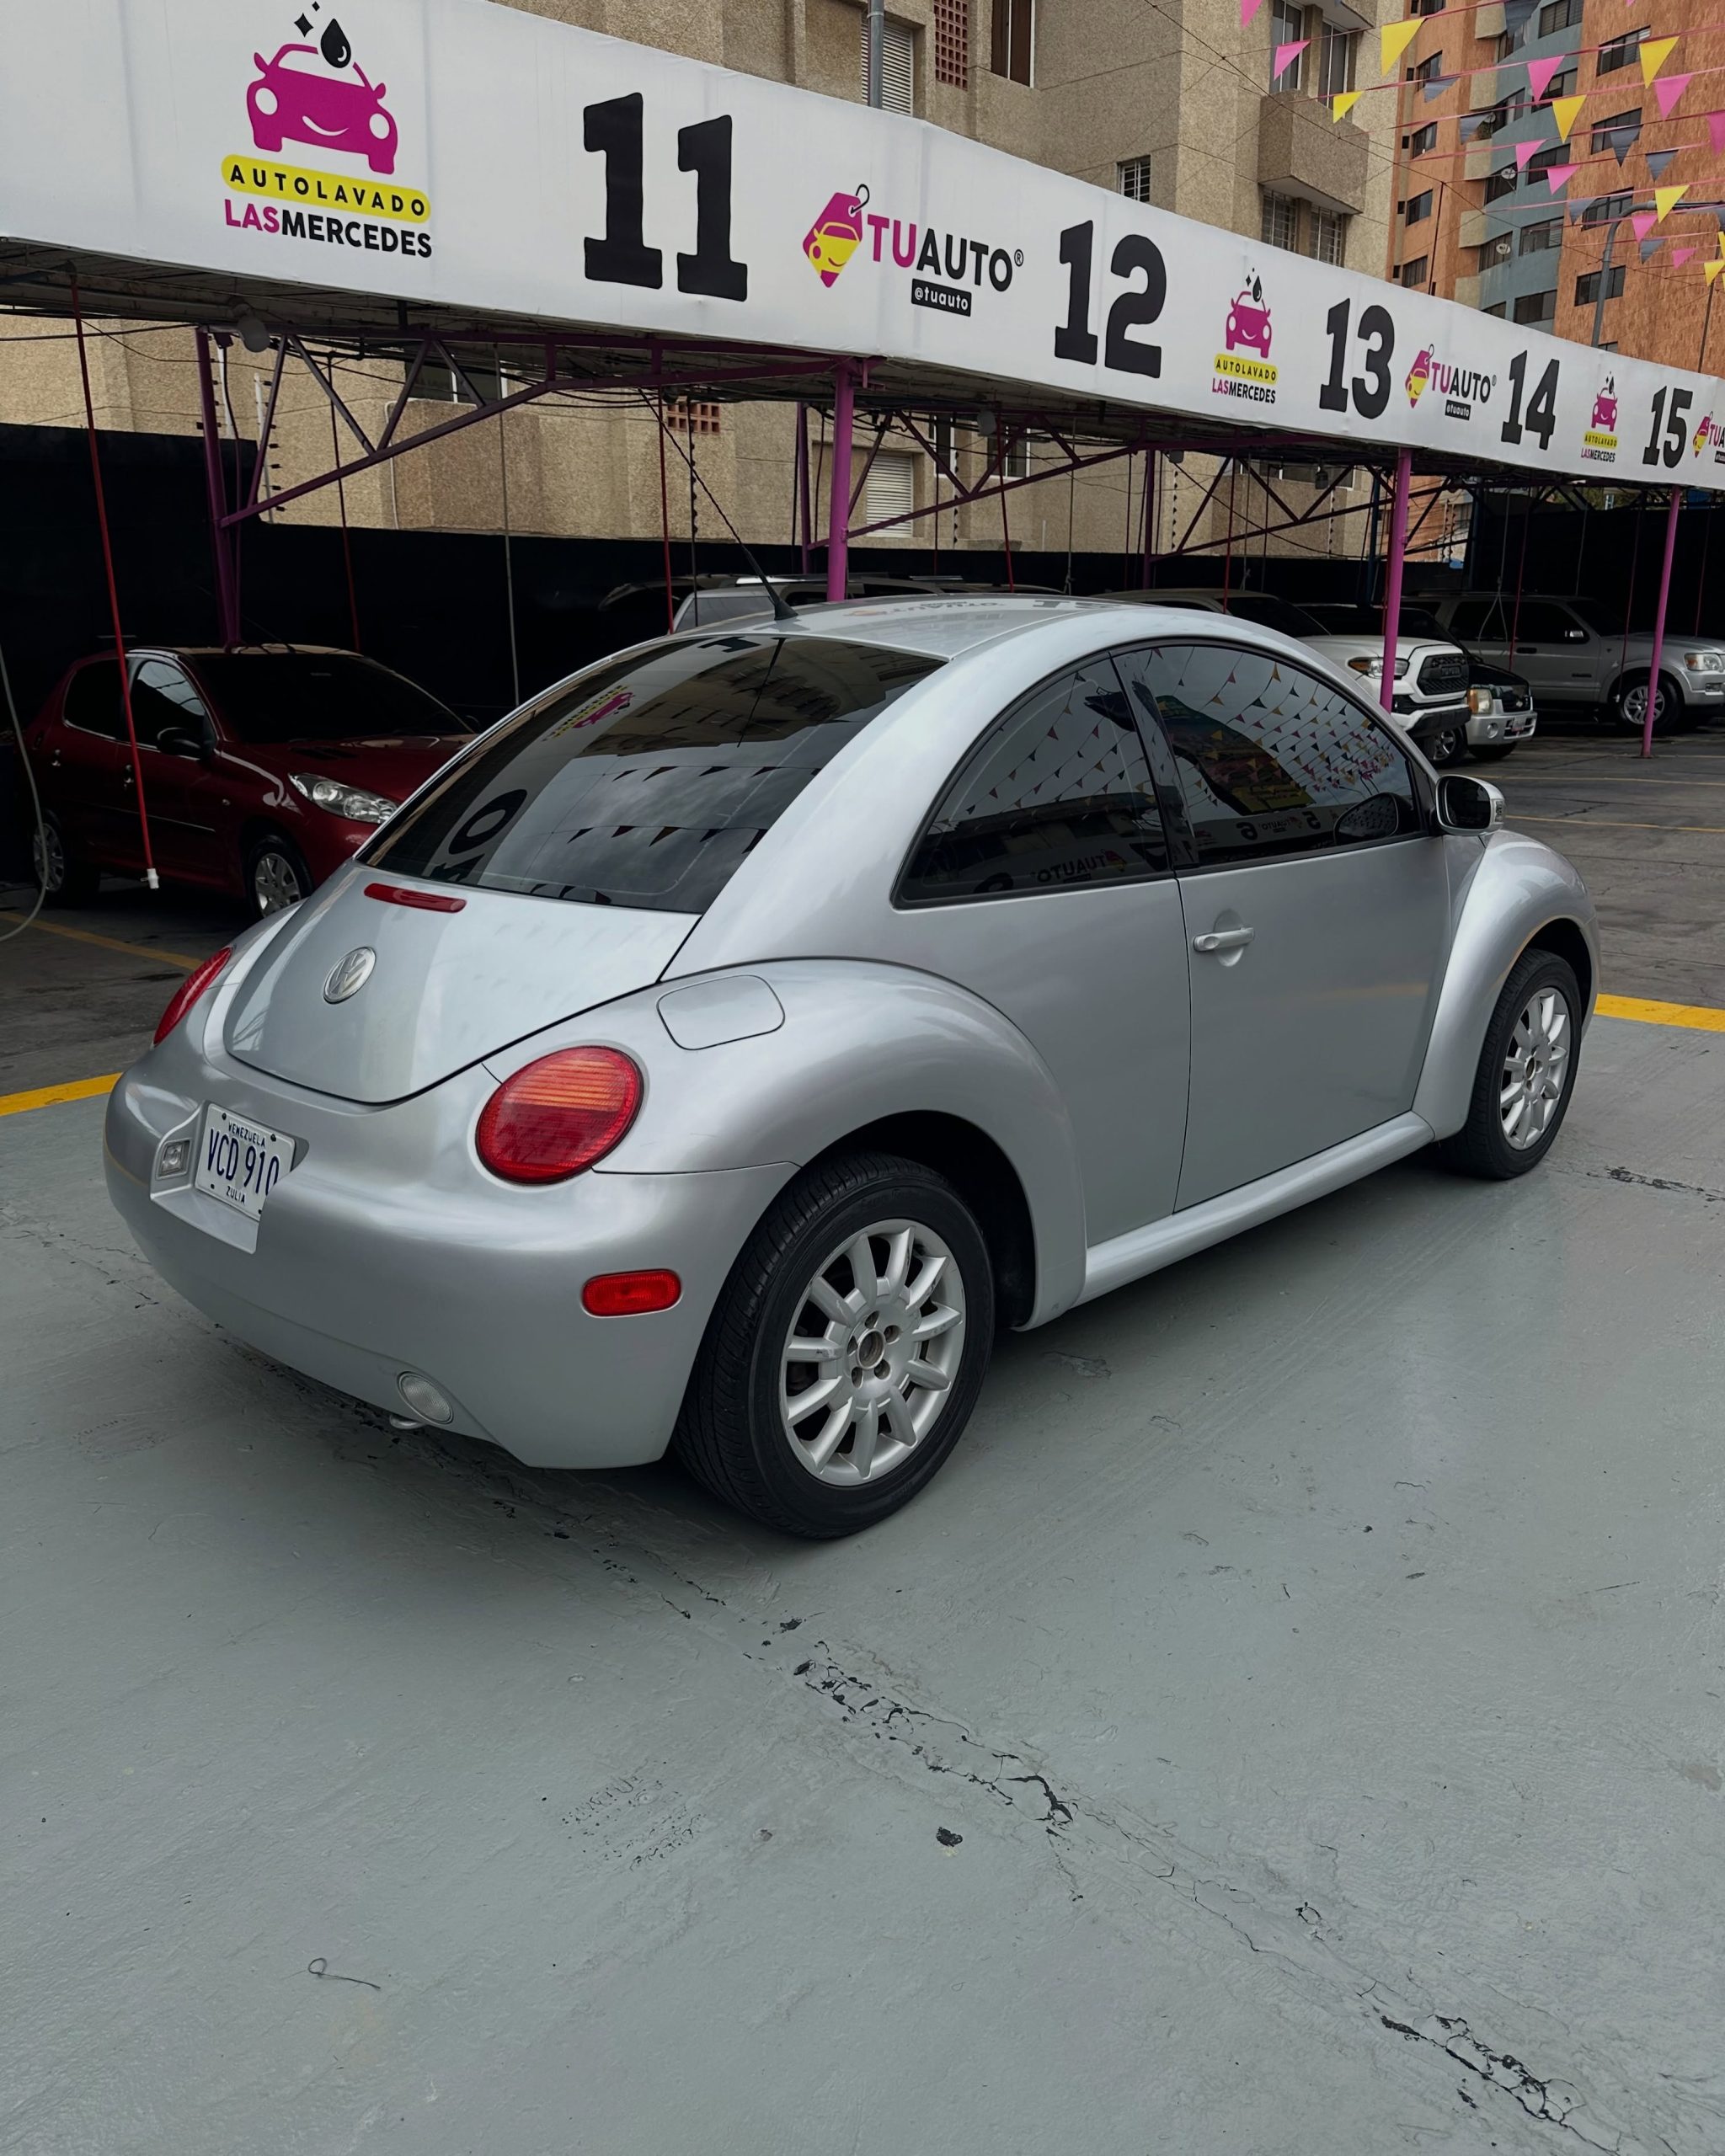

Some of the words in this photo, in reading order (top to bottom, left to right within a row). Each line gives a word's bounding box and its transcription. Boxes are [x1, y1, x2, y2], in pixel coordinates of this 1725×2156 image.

[230, 164, 425, 216] AUTOLAVADO
[583, 92, 747, 302] 11
[914, 286, 969, 311] @tuauto
[1055, 220, 1167, 378] 12
[1216, 359, 1276, 381] AUTOLAVADO
[1319, 298, 1395, 419] 13
[1501, 350, 1560, 451] 14
[1642, 386, 1693, 468] 15
[207, 1129, 239, 1182] VCD
[243, 1145, 280, 1197] 910
[228, 1122, 265, 1148] VENEZUELA
[226, 1186, 245, 1204] ZULIA
